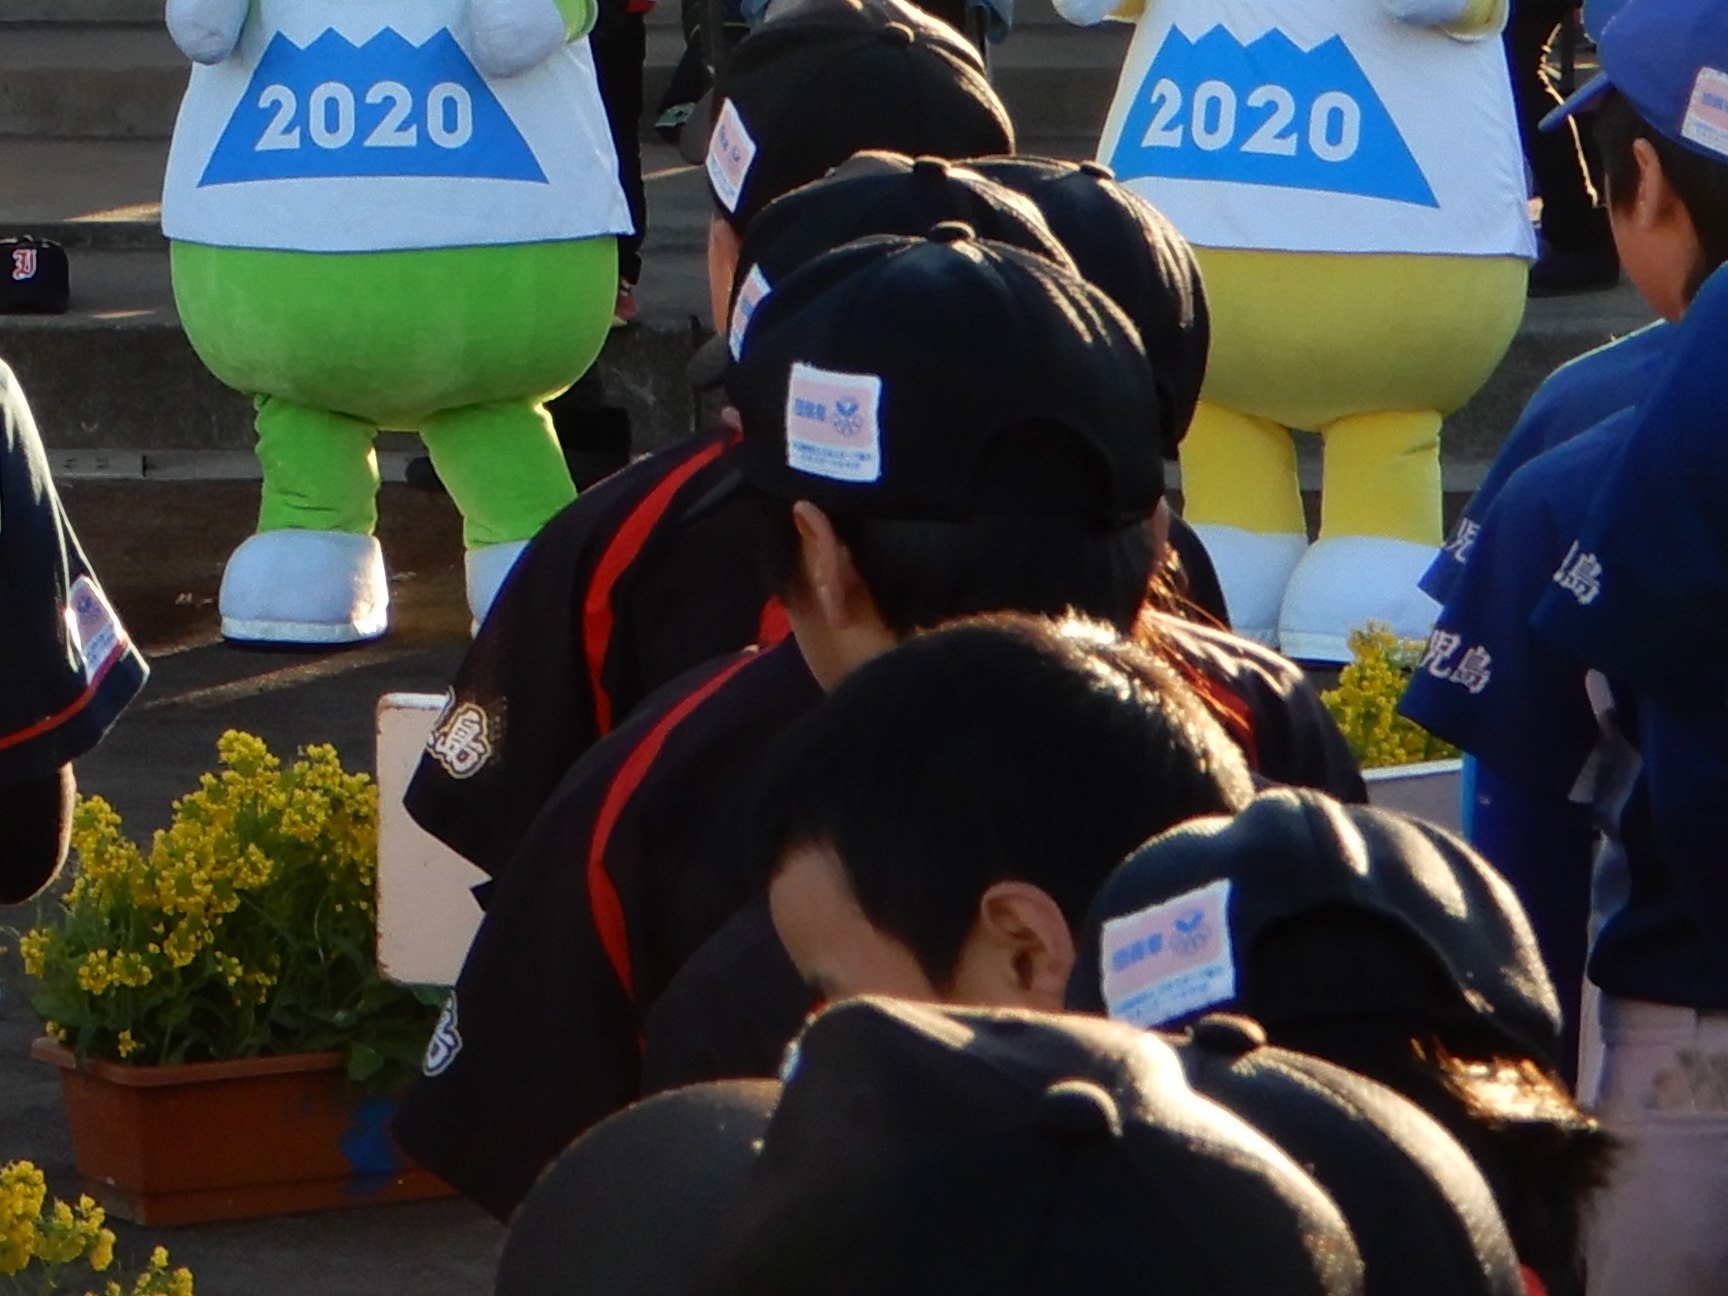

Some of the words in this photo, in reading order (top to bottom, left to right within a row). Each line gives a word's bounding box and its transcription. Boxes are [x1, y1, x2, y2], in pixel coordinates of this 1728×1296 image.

[254, 81, 474, 153] 2020
[1141, 76, 1363, 161] 2020
[1552, 539, 1603, 605] 島
